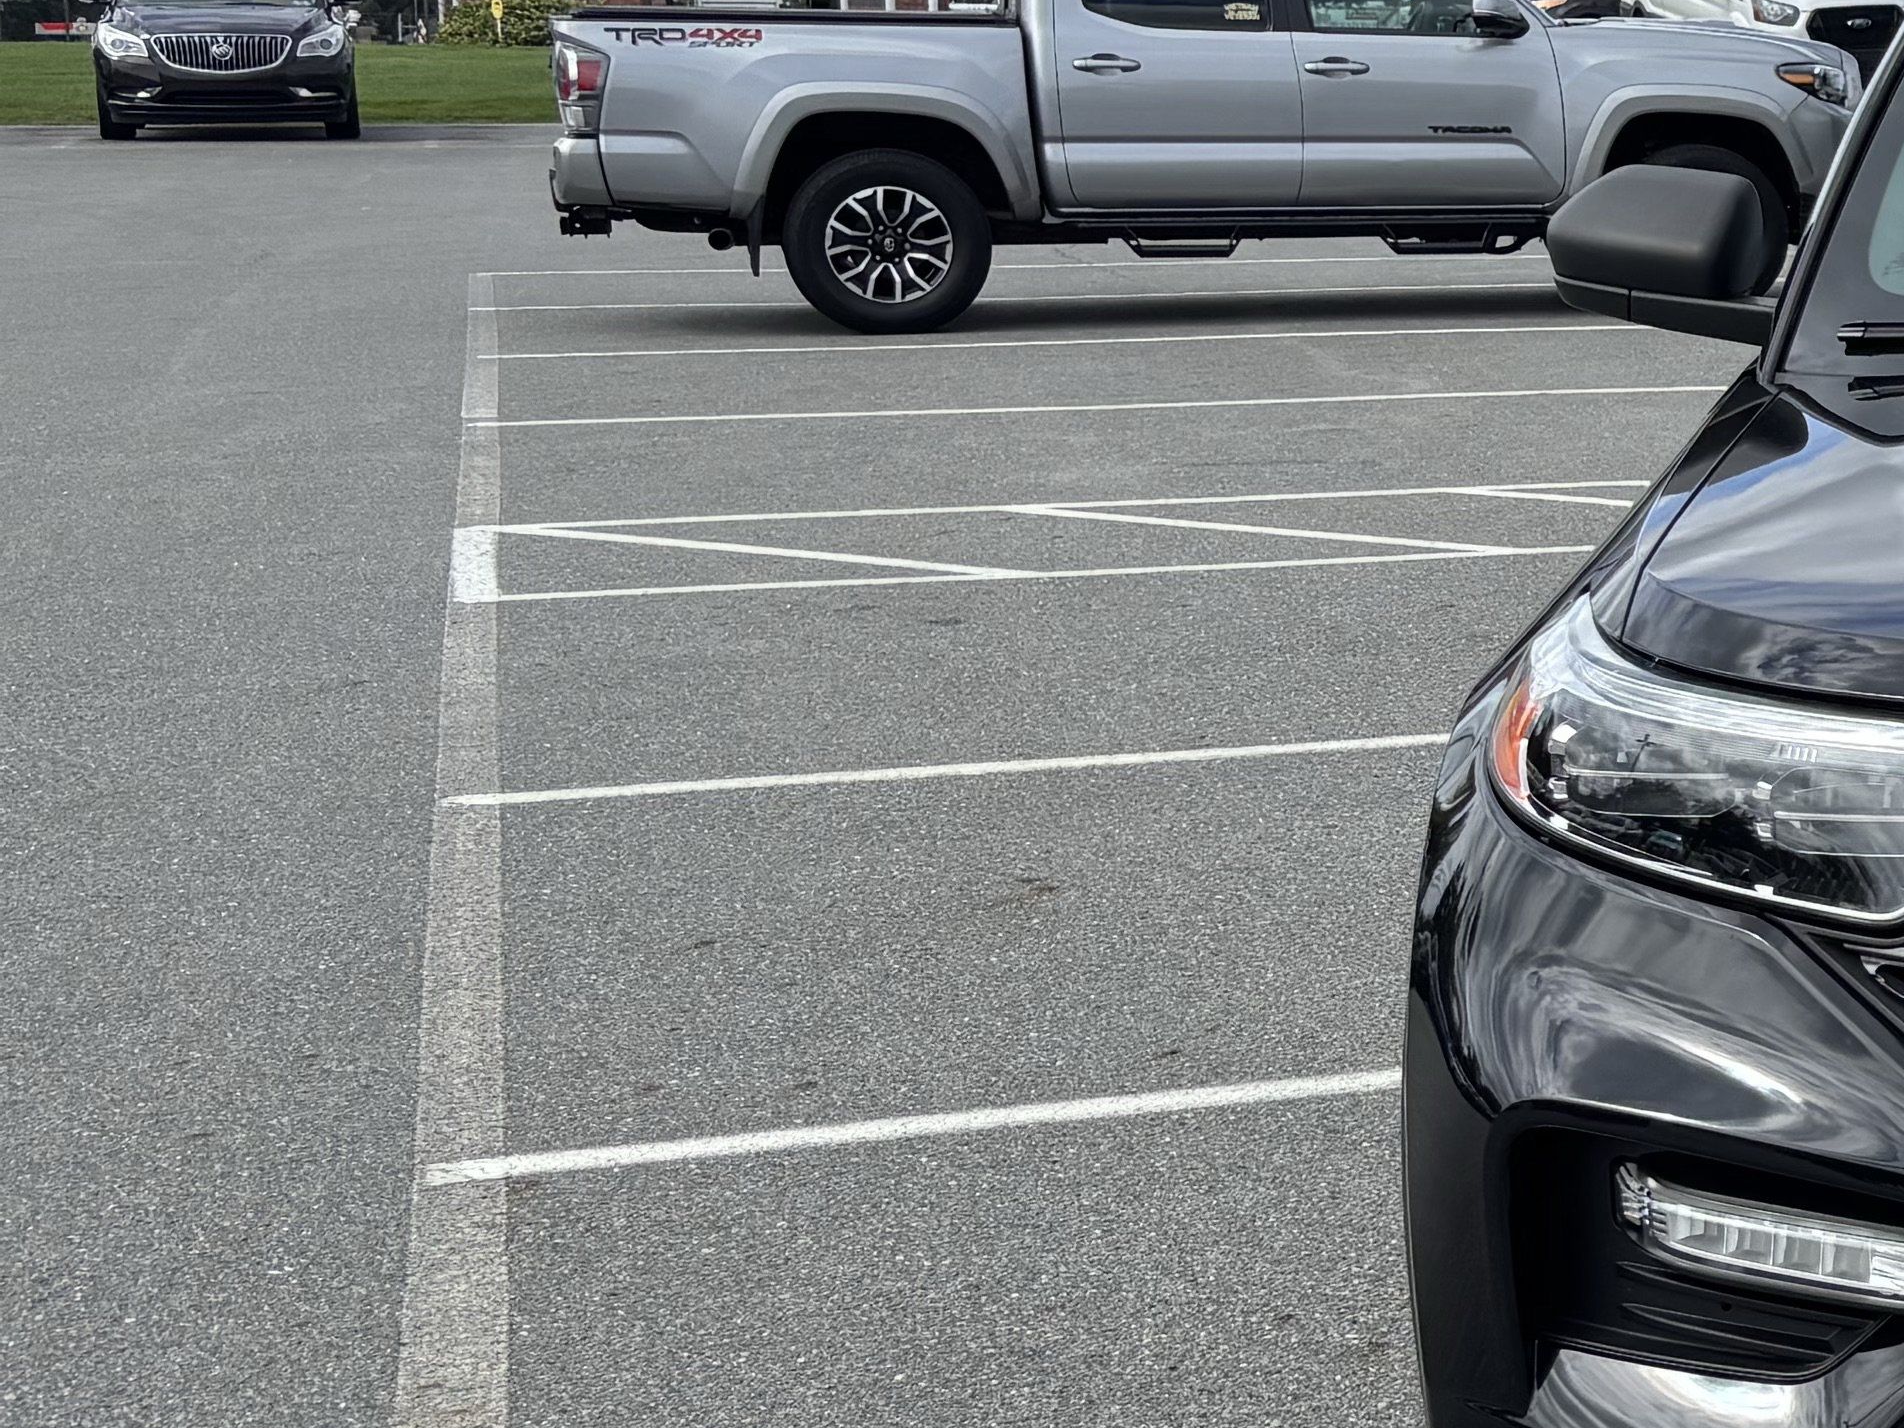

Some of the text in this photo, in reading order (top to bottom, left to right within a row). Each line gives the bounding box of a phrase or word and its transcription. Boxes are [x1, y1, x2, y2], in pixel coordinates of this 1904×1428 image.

[604, 27, 763, 46] TRD 4X4
[1427, 125, 1512, 134] TACOMA
